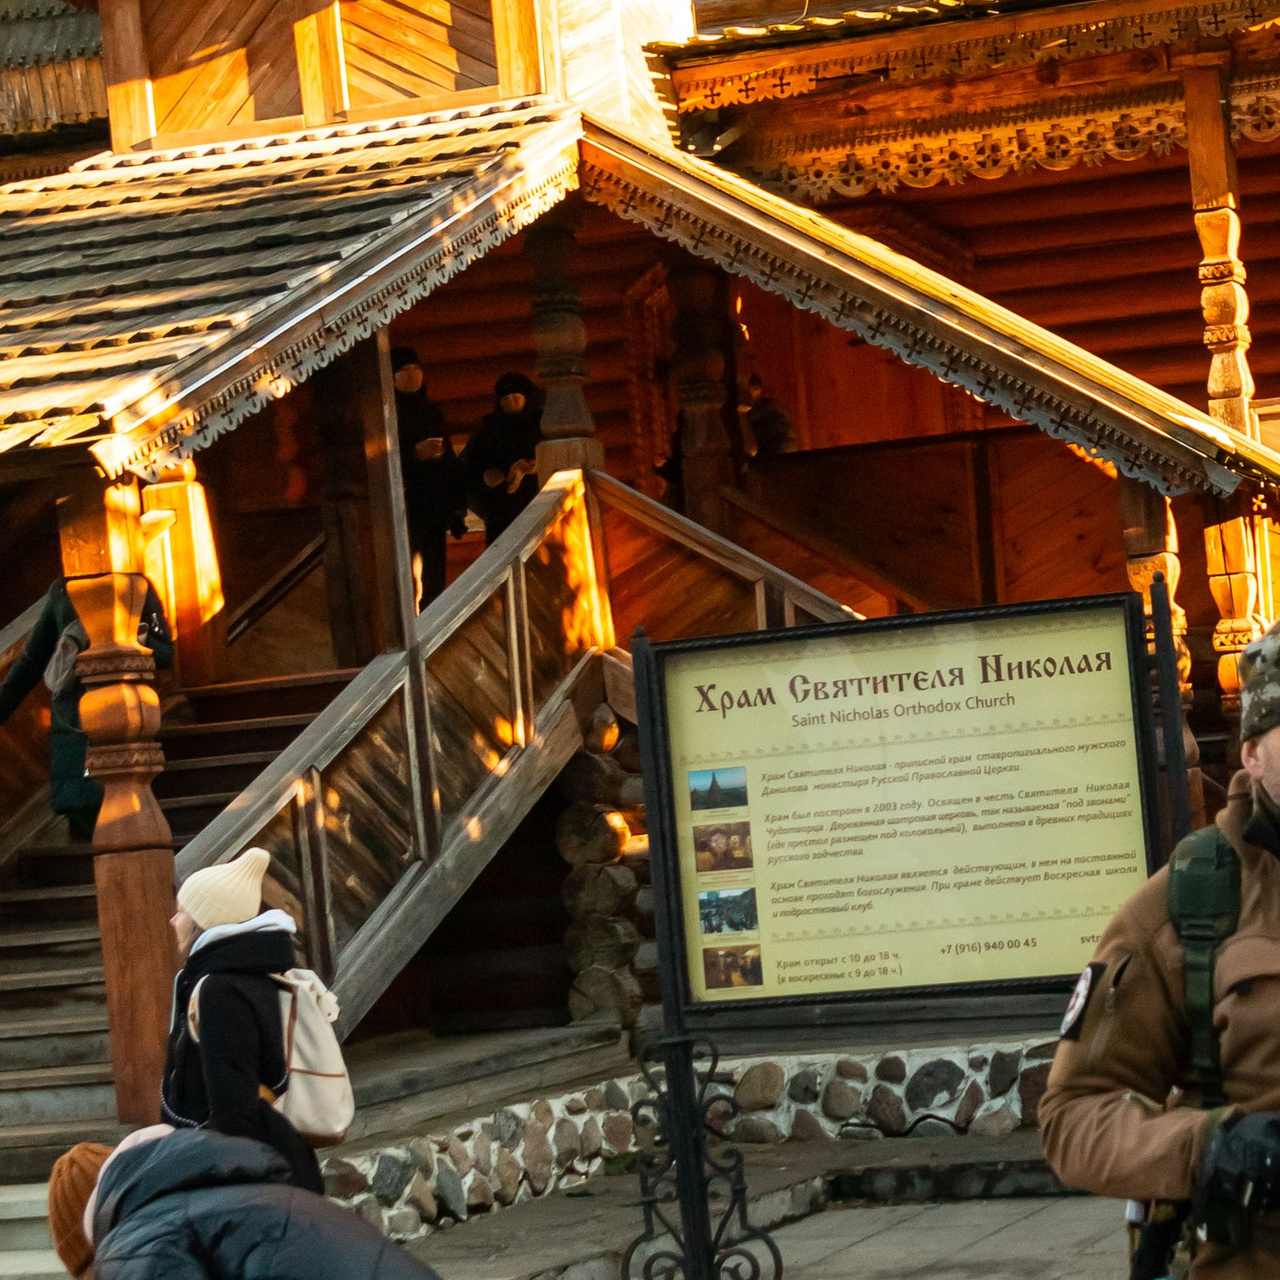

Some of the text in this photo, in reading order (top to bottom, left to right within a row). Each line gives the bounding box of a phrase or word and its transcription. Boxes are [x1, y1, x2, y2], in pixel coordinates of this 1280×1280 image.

[694, 651, 1111, 719] Храм Святителя Николая
[791, 691, 1015, 727] Saint Nicholas Orthodox Church
[760, 772, 786, 784] Храм
[787, 766, 843, 779] Святителя
[844, 762, 887, 773] Николая
[893, 754, 946, 771] приписной
[947, 754, 972, 765] храм
[975, 744, 1076, 761] ставропигиального
[1076, 739, 1126, 753] мужского
[760, 784, 808, 797] Данилова
[812, 778, 869, 790] монастыря
[870, 772, 909, 787] Русской
[910, 765, 981, 783] Православной
[763, 813, 789, 824] Храм
[790, 810, 811, 819] был
[812, 807, 862, 817] построен
[864, 805, 870, 813] в
[872, 801, 897, 812] 2003
[927, 796, 973, 807] Освящен
[974, 795, 981, 803] в
[982, 792, 1015, 802] честь
[1017, 786, 1078, 799] Святителя
[1085, 781, 1130, 792] Николая
[828, 818, 885, 832] Деревянная
[886, 813, 936, 825] шатровая
[980, 807, 1000, 816] так
[1001, 802, 1059, 814] называемая
[766, 839, 785, 851] (где
[787, 837, 828, 849] престол
[829, 833, 878, 846] размещен
[879, 828, 897, 839] под
[1027, 818, 1033, 826] в
[1034, 814, 1075, 827] древних
[1076, 809, 1132, 823] традициях
[766, 852, 810, 866] русского
[769, 881, 795, 892] Храм
[796, 876, 855, 888] Святителя
[855, 872, 899, 883] Николая
[899, 868, 948, 879] является
[1030, 860, 1036, 868] в
[1037, 858, 1058, 867] нем
[1059, 857, 1072, 865] на
[1073, 850, 1136, 864] постоянной
[770, 894, 804, 904] основе
[805, 889, 854, 903] проходят
[930, 880, 951, 892] При
[951, 879, 982, 891] храме
[983, 874, 1041, 886] действует
[1042, 868, 1100, 881] Воскресная
[1104, 865, 1137, 875] школа
[772, 910, 778, 918] и
[778, 901, 849, 918] подростковый
[939, 936, 1037, 956] +7 (916) 940 00 45
[1080, 934, 1101, 944] svtr
[775, 959, 801, 969] Храм
[803, 956, 838, 967] открыт
[840, 955, 846, 963] с
[848, 952, 861, 962] 10
[862, 953, 876, 963] до
[878, 950, 890, 960] 18
[787, 971, 845, 983] воскресенье
[847, 970, 853, 978] с
[854, 968, 861, 977] 9
[862, 969, 875, 978] до
[877, 966, 888, 975] 18
